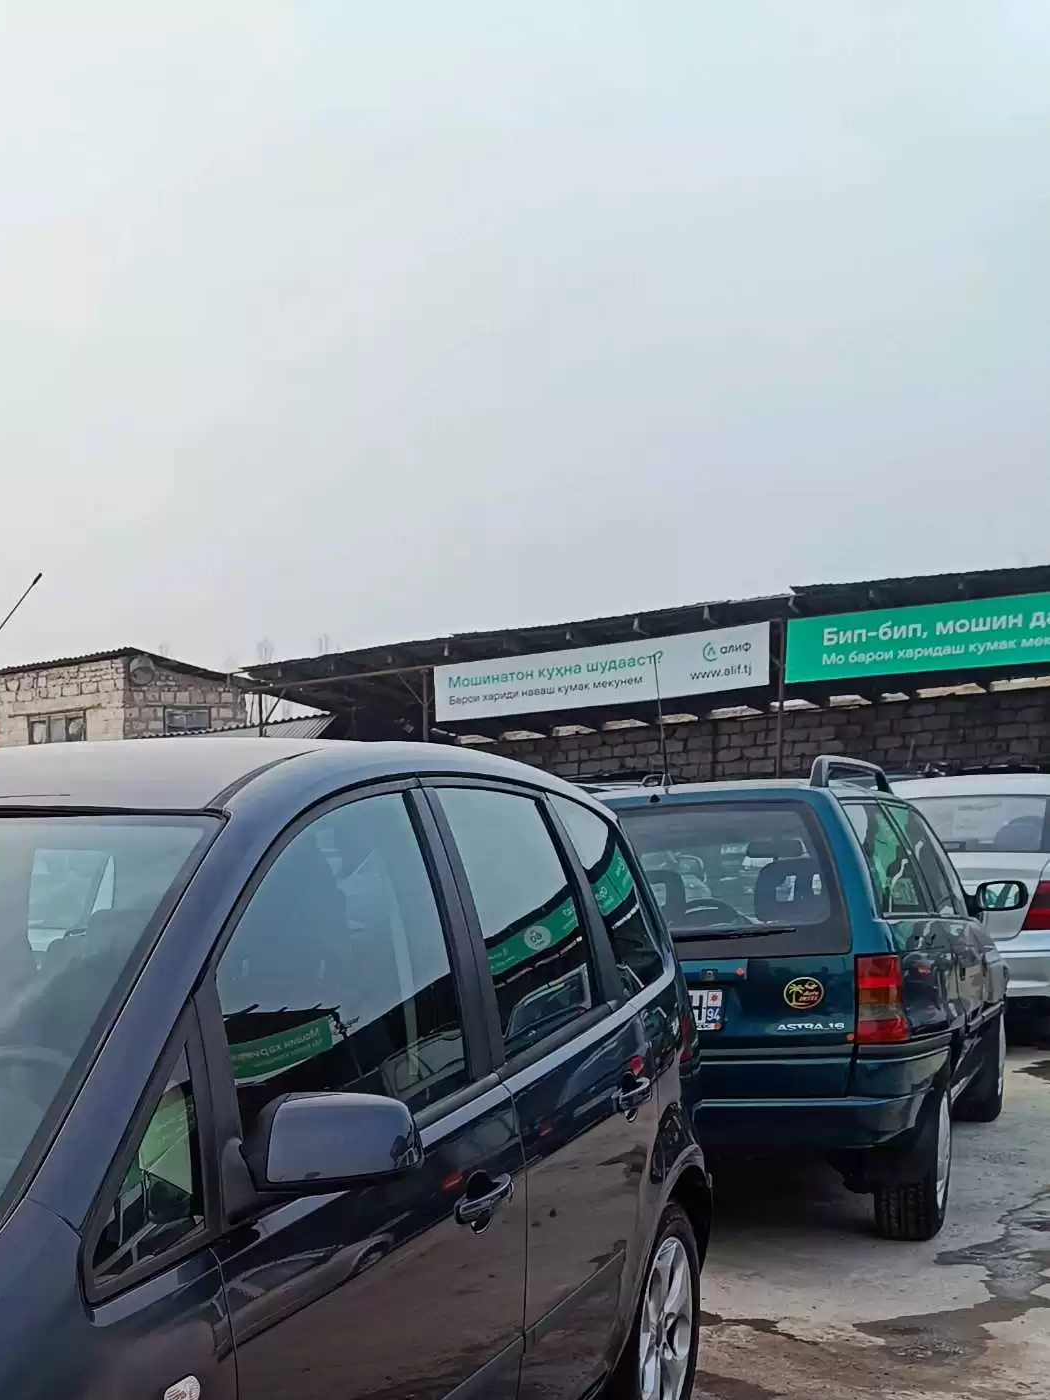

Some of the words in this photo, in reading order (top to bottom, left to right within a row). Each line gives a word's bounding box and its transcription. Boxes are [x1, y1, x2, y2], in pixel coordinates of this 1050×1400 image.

[822, 621, 928, 646] Бип-бип,
[935, 612, 1023, 636] мошин
[719, 642, 752, 655] алиф
[822, 653, 846, 665] Мо
[848, 648, 894, 665] барои
[968, 639, 1017, 655] кумак
[448, 671, 535, 689] Мошинатон
[586, 650, 664, 675] шудааст?
[690, 661, 753, 681] www.alif.tj
[449, 692, 481, 706] Барои
[557, 682, 591, 695] кумак
[706, 1007, 721, 1021] 94
[777, 1023, 825, 1031] ASTRA
